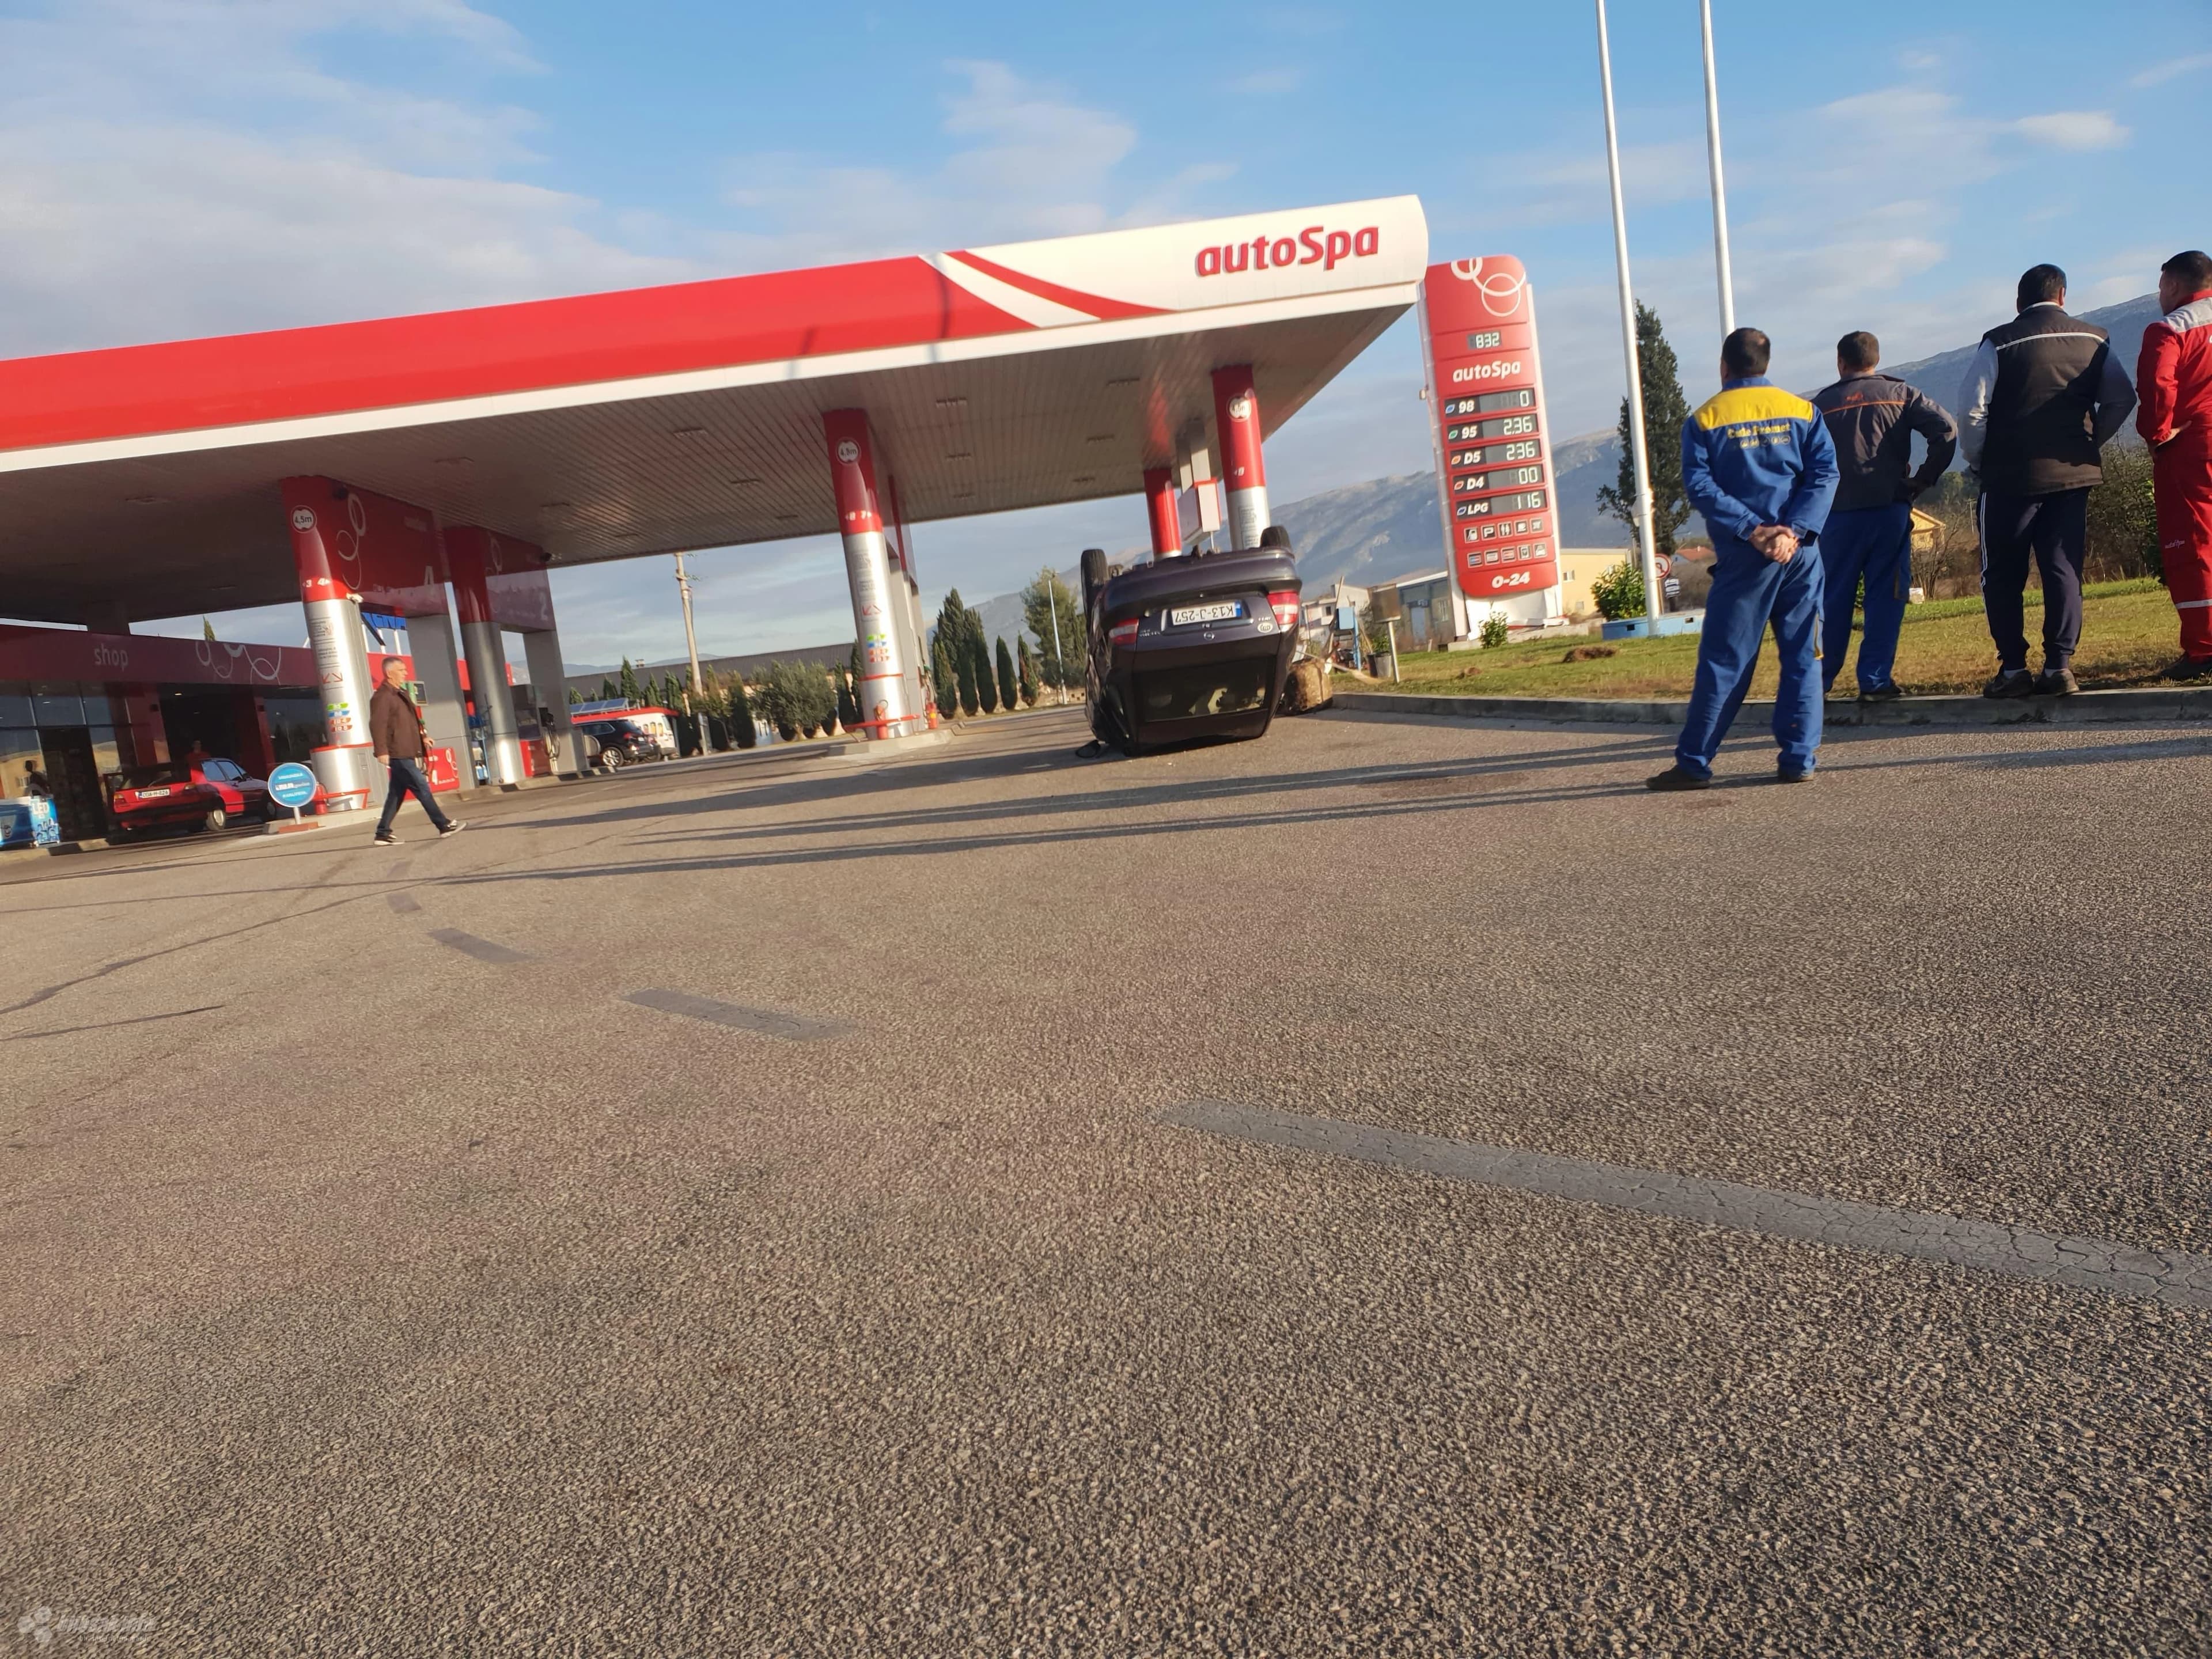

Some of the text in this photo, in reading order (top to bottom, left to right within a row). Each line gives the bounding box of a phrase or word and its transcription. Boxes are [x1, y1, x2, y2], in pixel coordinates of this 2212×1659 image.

[1196, 226, 1378, 276] autoSpa
[1475, 332, 1500, 349] 832
[1453, 360, 1521, 383] autoSpa
[1459, 400, 1475, 414] 98
[1461, 425, 1478, 439] 95
[1464, 450, 1482, 465] D5
[1467, 476, 1484, 490] D4
[1467, 502, 1489, 515] LPG
[1491, 571, 1531, 588] 0-24
[1175, 605, 1234, 623] K13-J-257
[94, 642, 128, 673] shop
